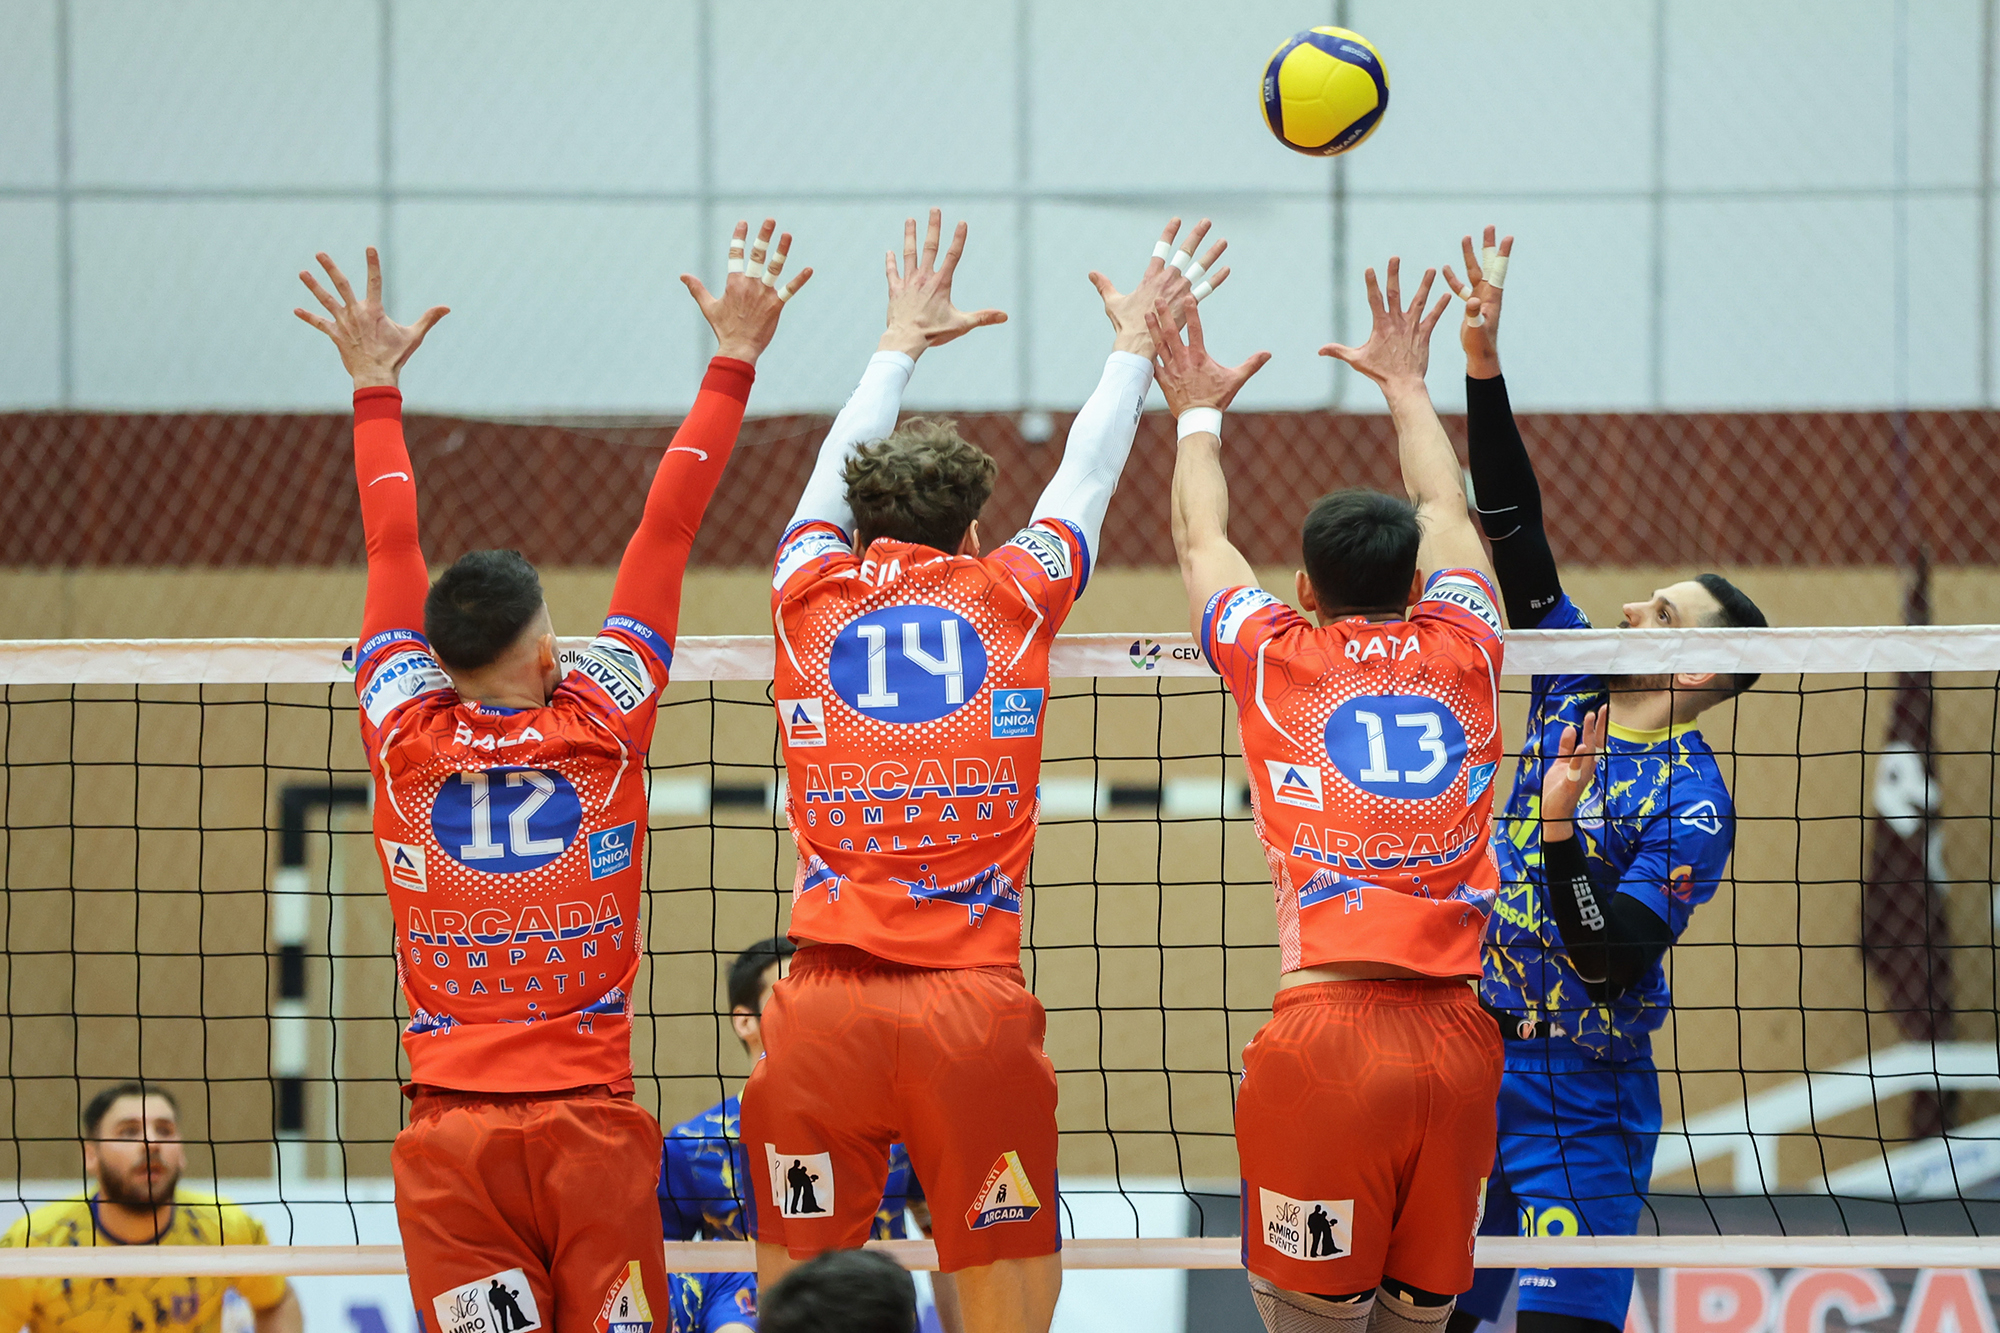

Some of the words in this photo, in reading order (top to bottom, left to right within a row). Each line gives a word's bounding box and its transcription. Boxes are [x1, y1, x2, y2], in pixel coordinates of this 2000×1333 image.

[362, 632, 392, 654] ARCADA
[393, 630, 412, 640] CSM
[634, 624, 653, 639] CSM
[857, 619, 964, 709] 14
[1172, 648, 1201, 660] CEV
[994, 714, 1035, 727] UNIQA
[1354, 710, 1449, 784] 13
[806, 755, 1020, 804] ARCADA
[459, 770, 565, 860] 12
[806, 799, 1020, 827] COMPANY
[1291, 813, 1480, 870] ARCADA
[592, 848, 630, 869] UNIQA
[407, 892, 624, 947] ARCADA
[410, 931, 625, 969] COMPANY
[973, 1169, 1001, 1211] GALATI
[984, 1207, 1024, 1225] ARCADA
[1268, 1220, 1300, 1243] AMIRO
[1268, 1232, 1298, 1255] EVENTS
[601, 1278, 624, 1320] GALATI
[1625, 1268, 1998, 1333] RCA
[448, 1317, 486, 1333] MIRO
